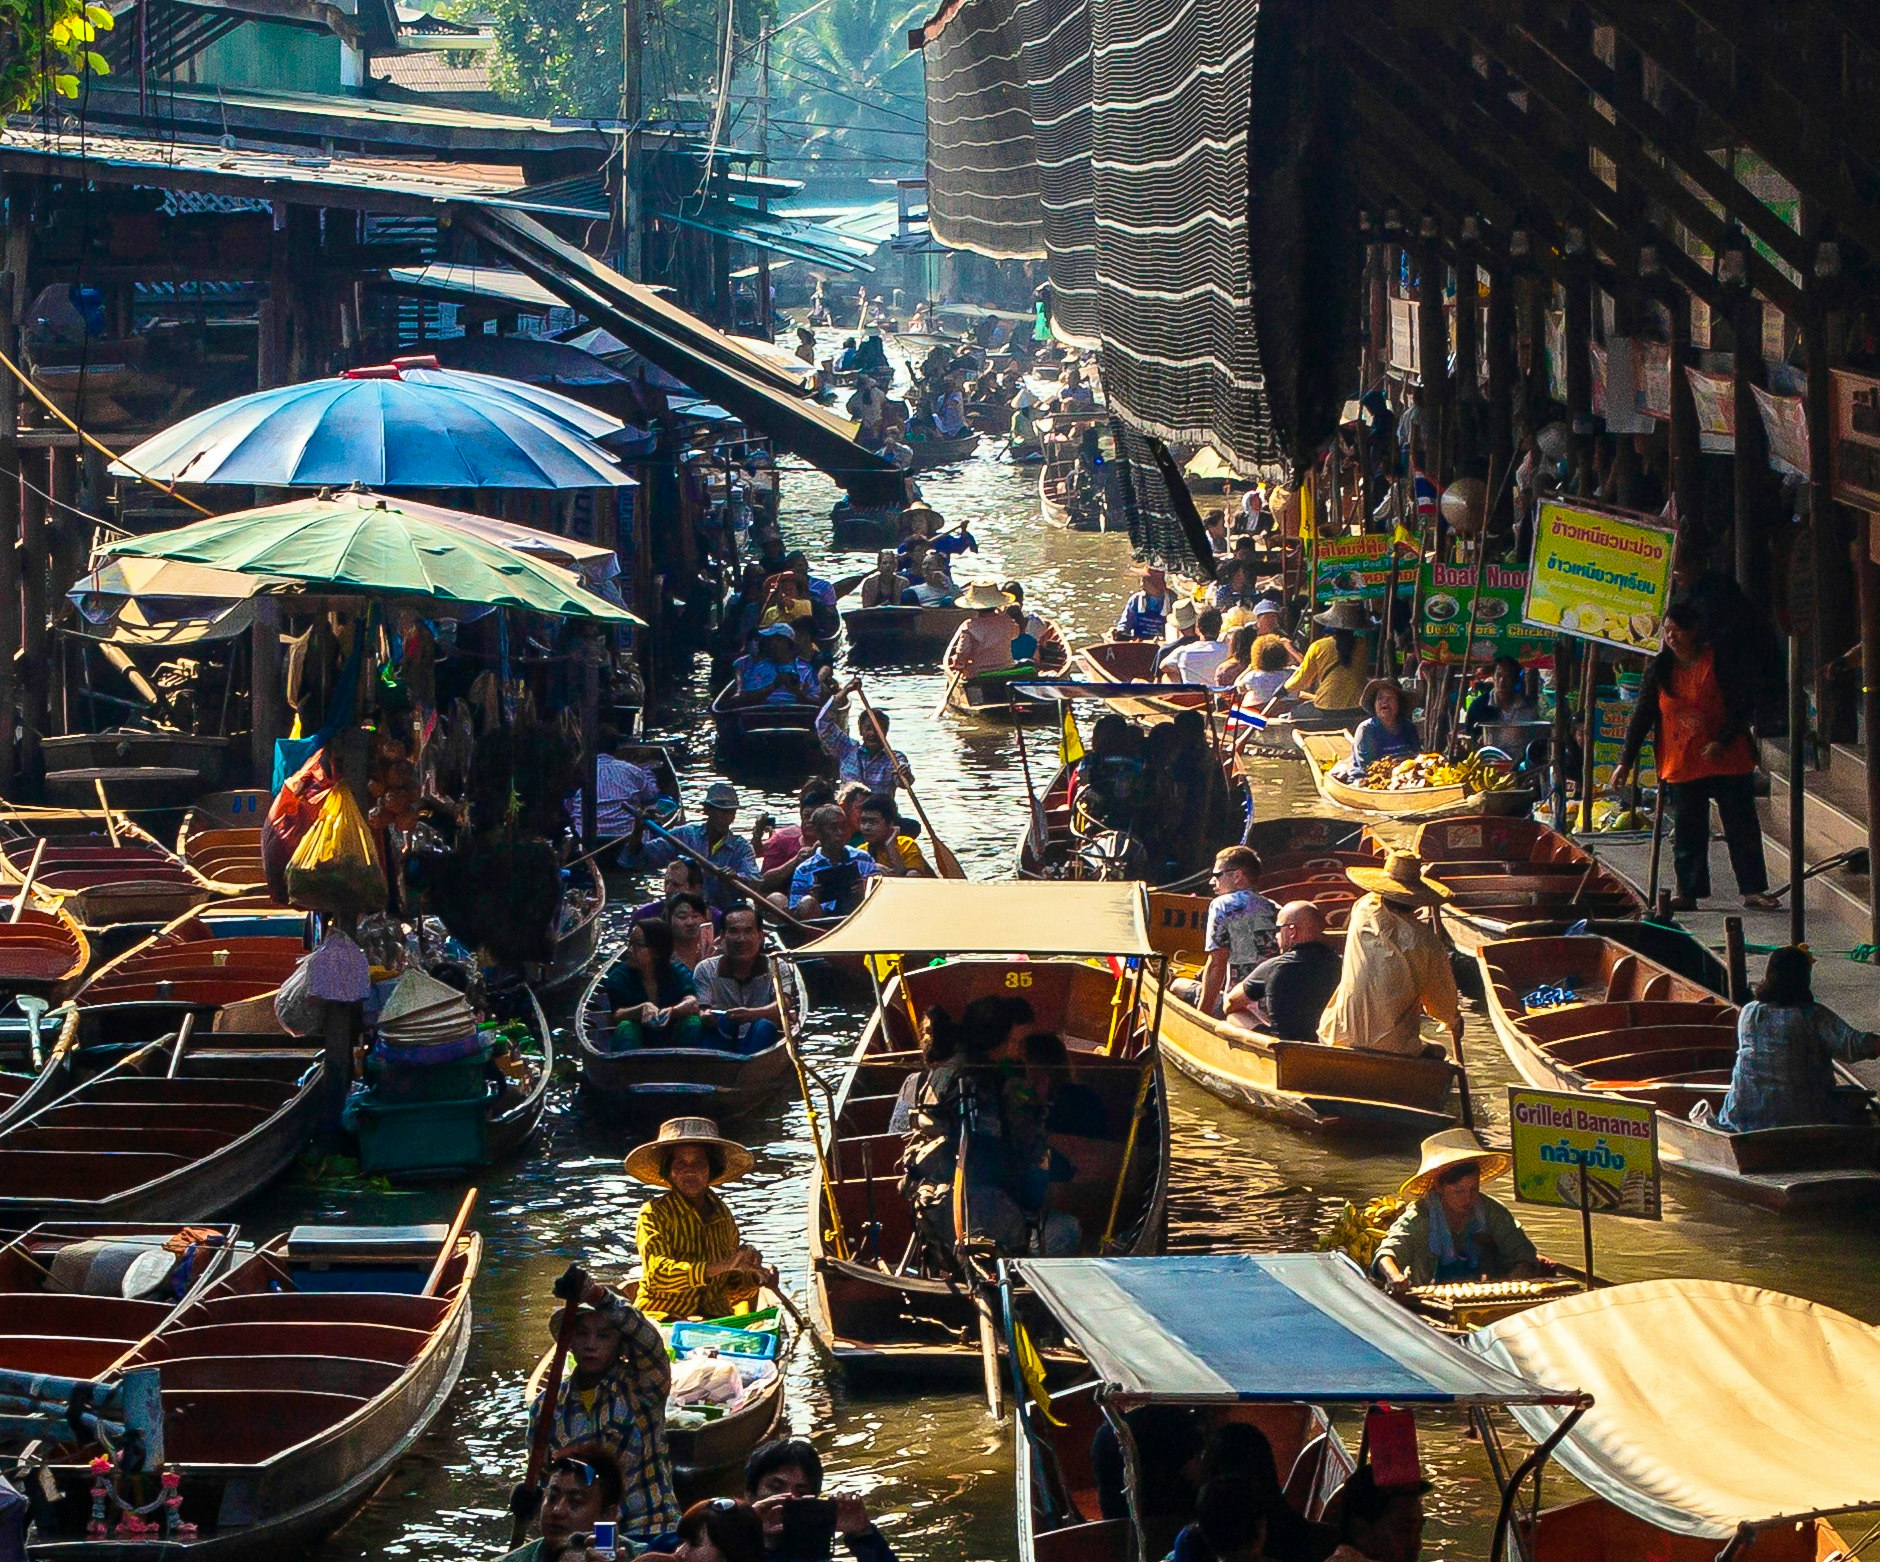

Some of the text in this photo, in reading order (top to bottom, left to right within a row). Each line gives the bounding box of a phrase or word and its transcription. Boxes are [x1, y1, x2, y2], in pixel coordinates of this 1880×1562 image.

[1433, 563, 1529, 589] Boat Noo
[1424, 622, 1458, 636] Duck
[1507, 624, 1560, 639] Chicken
[1005, 971, 1033, 988] 35
[1515, 1102, 1651, 1139] Grilled Bananas
[1540, 1138, 1625, 1171] กล้วยปิ้ง
